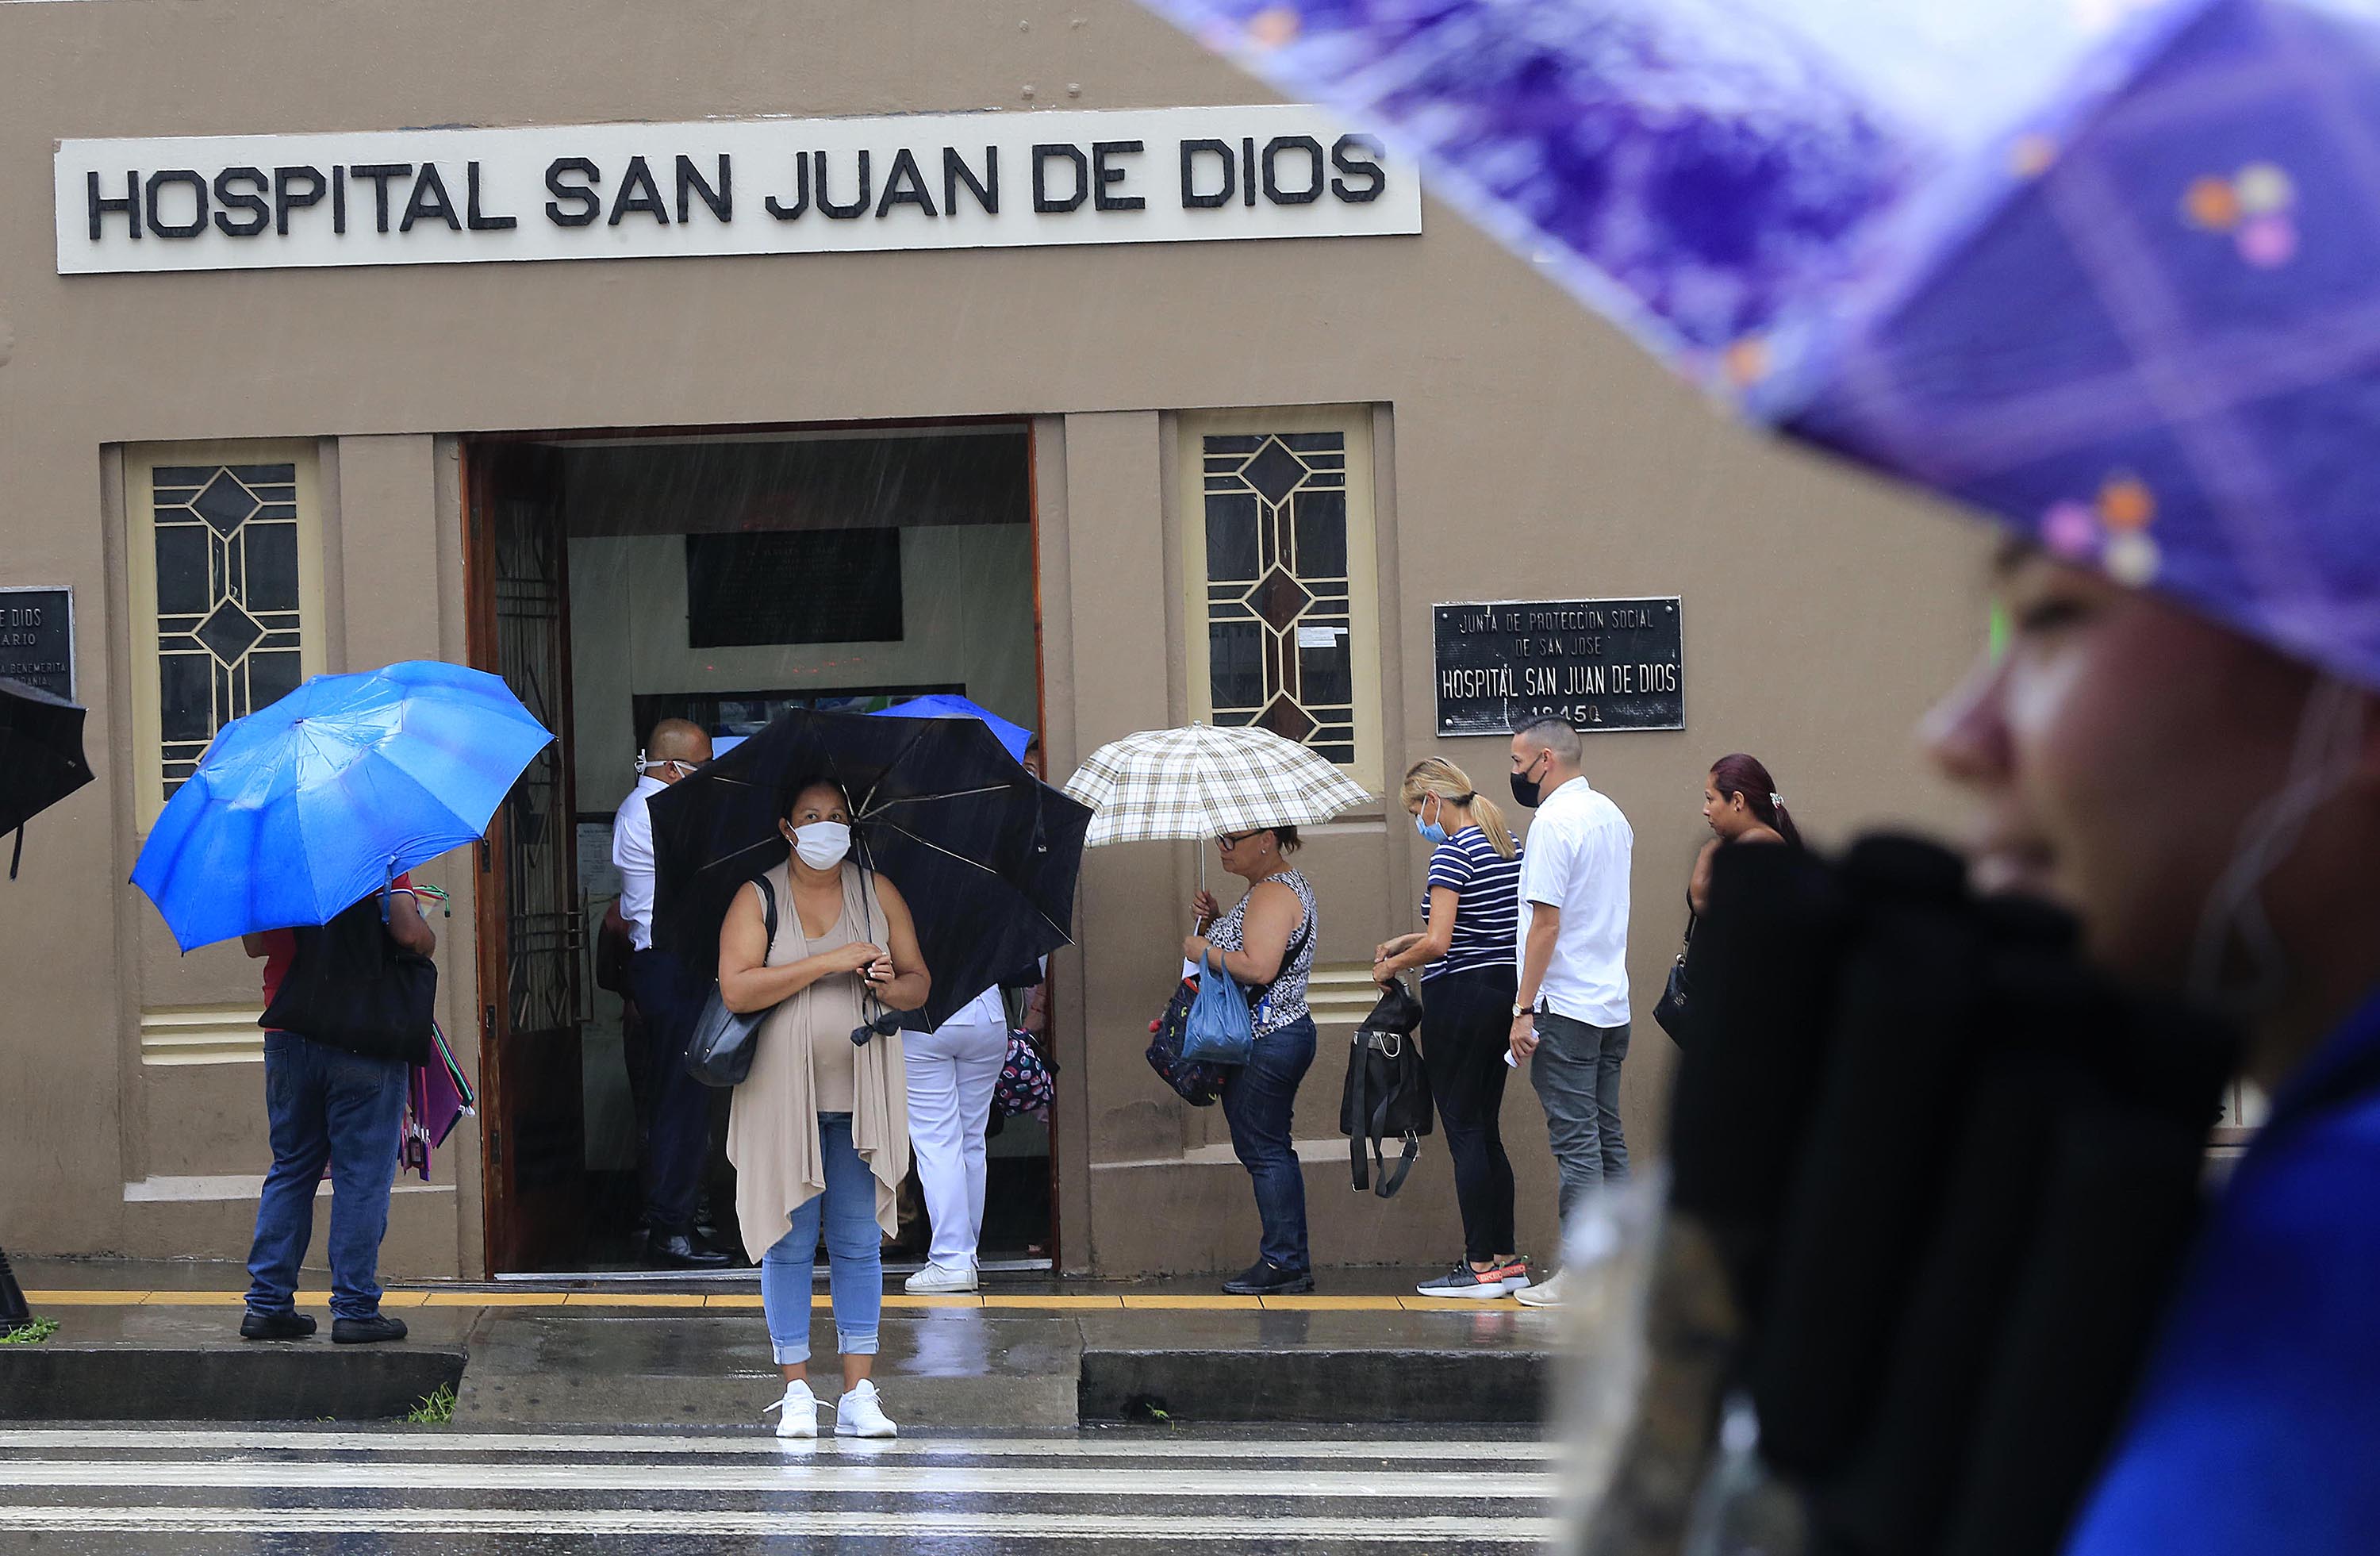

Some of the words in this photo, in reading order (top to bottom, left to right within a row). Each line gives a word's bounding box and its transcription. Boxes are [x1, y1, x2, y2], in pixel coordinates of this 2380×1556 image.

[86, 160, 517, 240] HOSPITAL
[545, 153, 732, 228] SAN
[764, 145, 1000, 220] JUAN
[1032, 140, 1146, 213] DE
[1180, 133, 1387, 209] DIOS
[12, 608, 41, 627] DIOS
[1459, 613, 1498, 634] JUNTA
[1507, 613, 1522, 632] DE
[1530, 610, 1604, 632] PROTECCION
[1612, 609, 1653, 628] SOCIAL
[1515, 638, 1530, 657] DE
[1539, 637, 1563, 657] SAN
[1571, 636, 1602, 655] JOSE
[1442, 667, 1518, 698] HOSPITAL
[1526, 667, 1557, 696] SAN
[1564, 665, 1605, 695] JUAN
[1611, 664, 1633, 693] DE
[1639, 663, 1676, 692] DIOS
